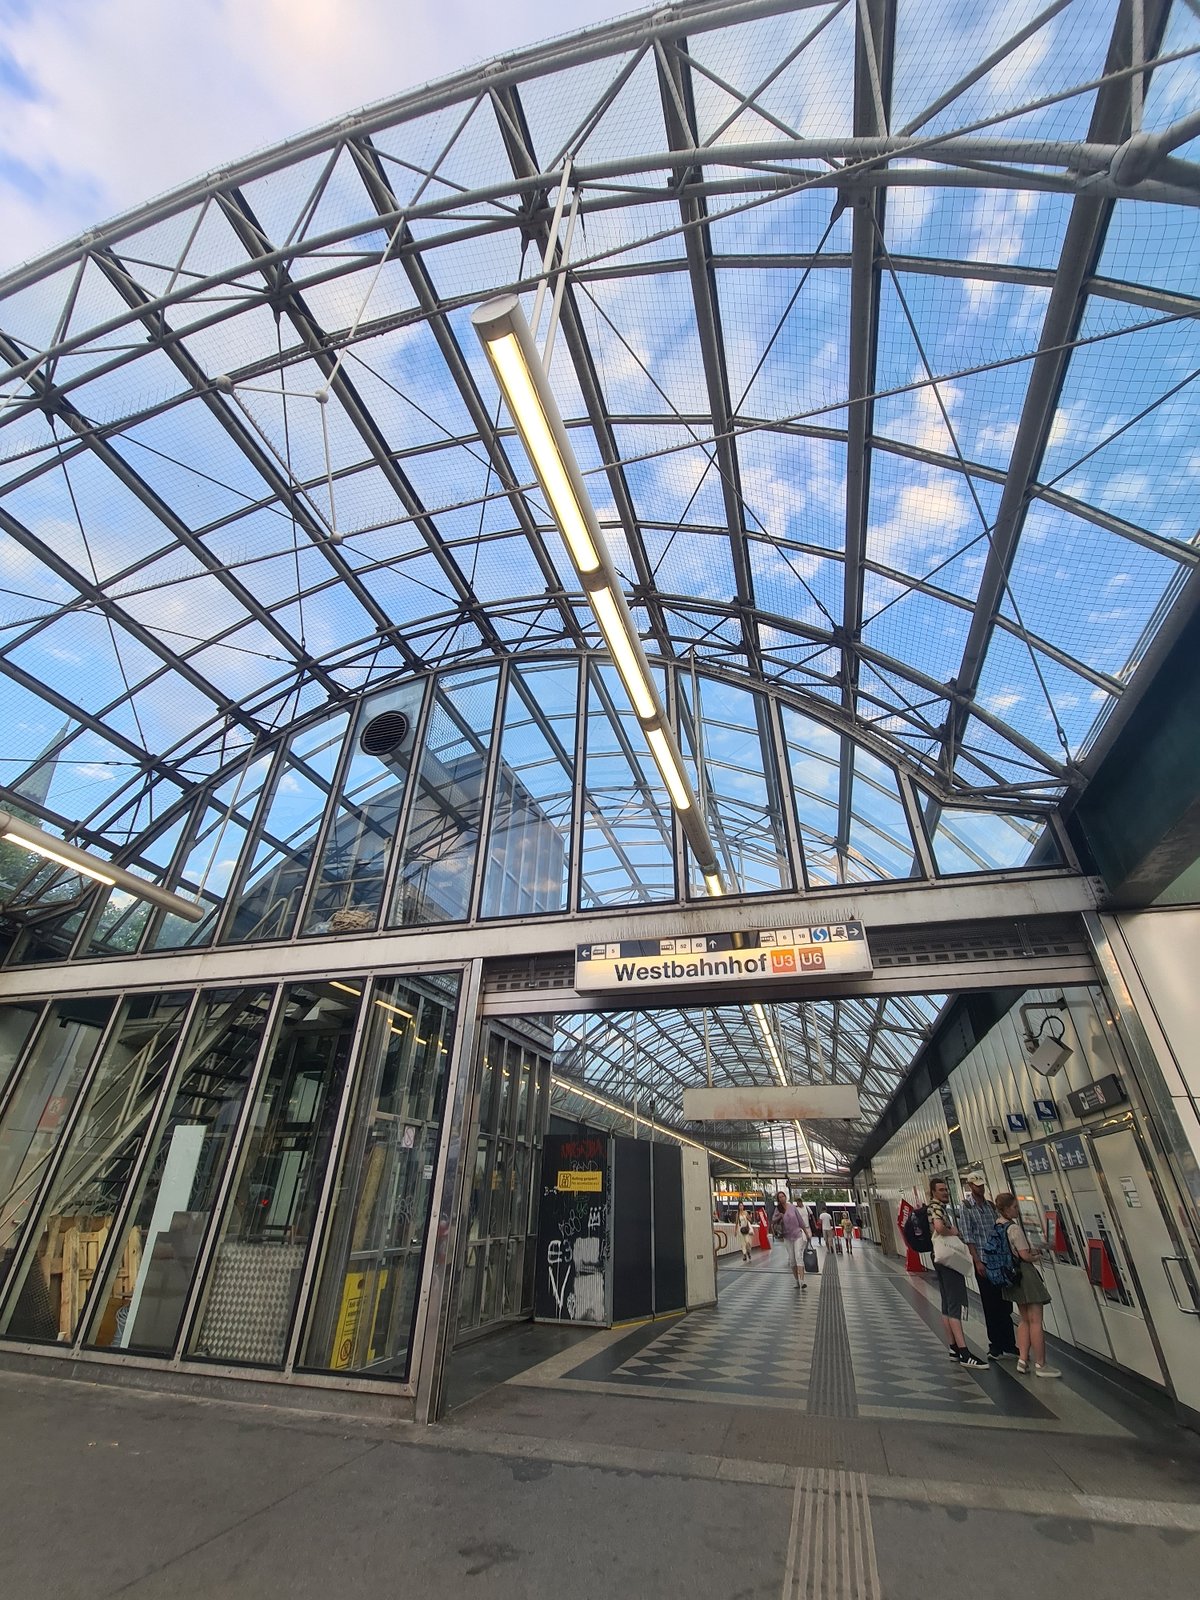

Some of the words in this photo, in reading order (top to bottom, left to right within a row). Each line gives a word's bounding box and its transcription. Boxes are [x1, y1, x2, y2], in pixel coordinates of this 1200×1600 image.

[614, 953, 767, 982] Westbahnhof
[773, 954, 794, 968] U3
[801, 952, 822, 966] U6
